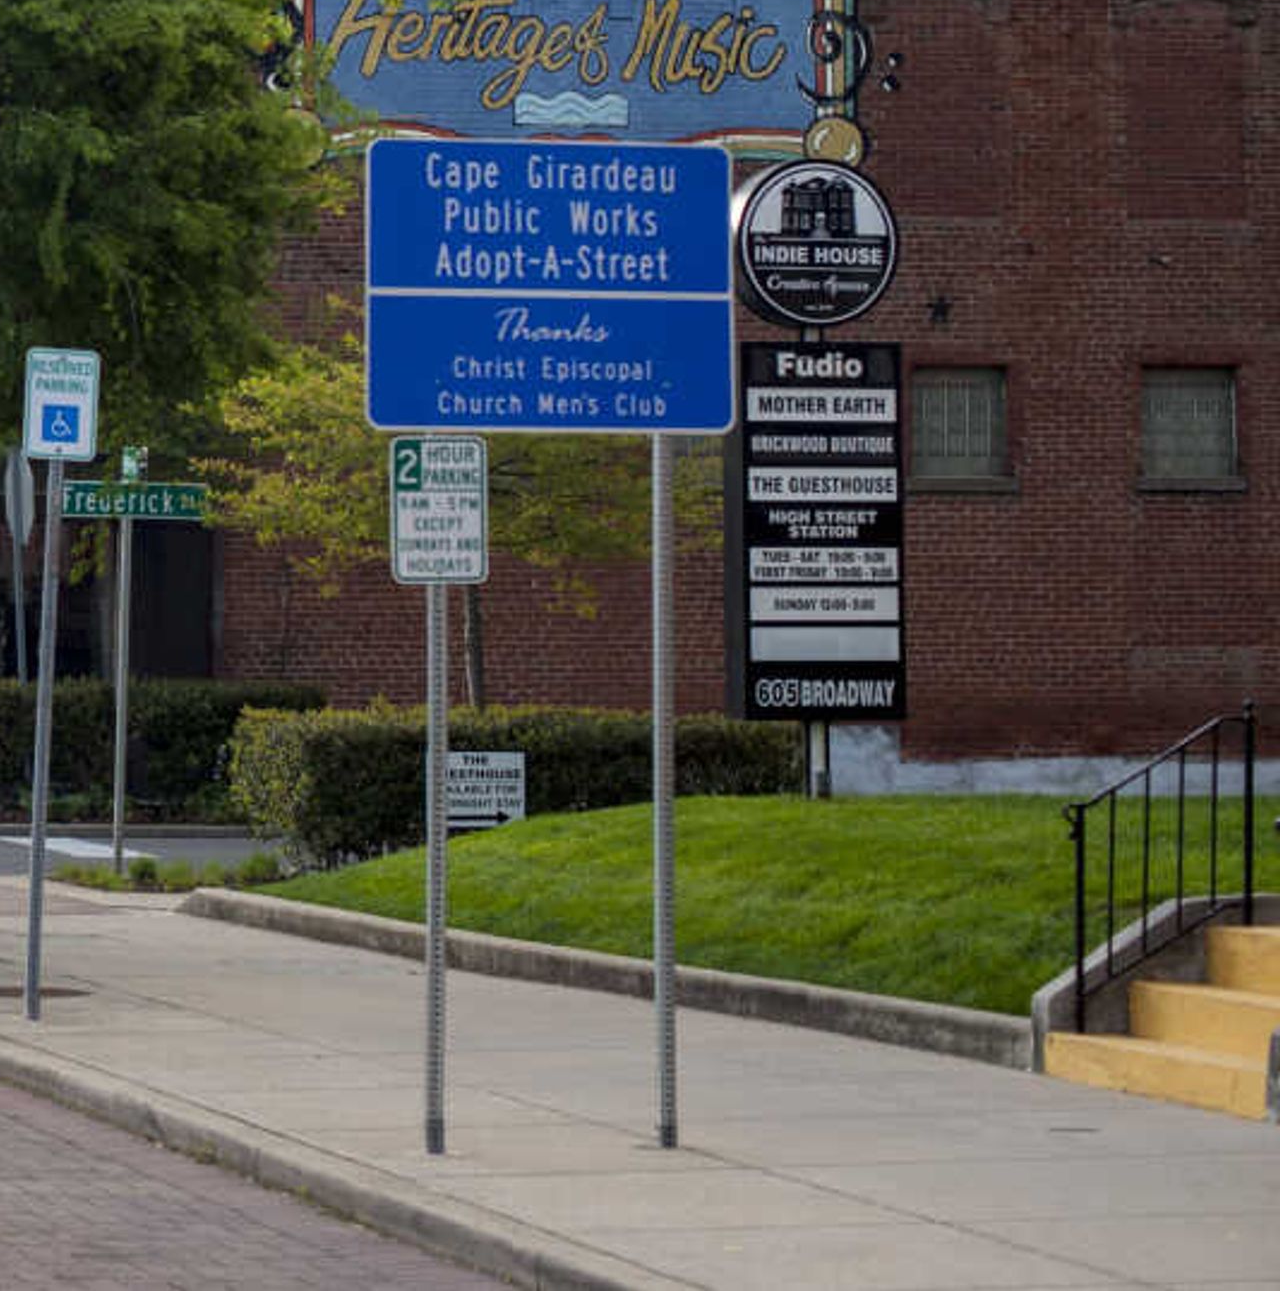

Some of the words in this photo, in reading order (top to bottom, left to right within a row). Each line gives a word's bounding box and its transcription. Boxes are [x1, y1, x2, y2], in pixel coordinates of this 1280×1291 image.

[573, 2, 610, 85] of
[424, 151, 501, 193] Cape
[527, 154, 677, 194] Girardeau
[443, 198, 541, 235] Public
[569, 200, 659, 238] Works
[434, 242, 670, 285] Adopt-A-Street
[753, 245, 809, 264] INDIE
[814, 247, 884, 266] HOUSE
[493, 306, 610, 343] Thanks
[452, 355, 526, 380] Christ
[540, 356, 653, 383] Episcopal
[776, 351, 864, 378] Fudio
[436, 390, 524, 415] Church
[538, 392, 600, 416] Men's
[614, 394, 668, 417] Club
[758, 396, 828, 414] MOTHER
[833, 397, 886, 414] EARTH
[751, 435, 827, 453] BRICKWOOD
[831, 436, 895, 453] BOUTIQUE
[397, 448, 418, 484] 2
[426, 447, 476, 463] HOUR
[424, 469, 480, 484] PARKING
[753, 476, 784, 494] THE
[62, 487, 174, 514] Frederick
[415, 517, 464, 531] EXCEPT
[768, 510, 811, 525] HIGH
[814, 511, 878, 525] STREET
[787, 525, 859, 539] STATION
[755, 679, 800, 707] 605
[801, 680, 896, 707] BROADWAY
[462, 753, 489, 765] THE
